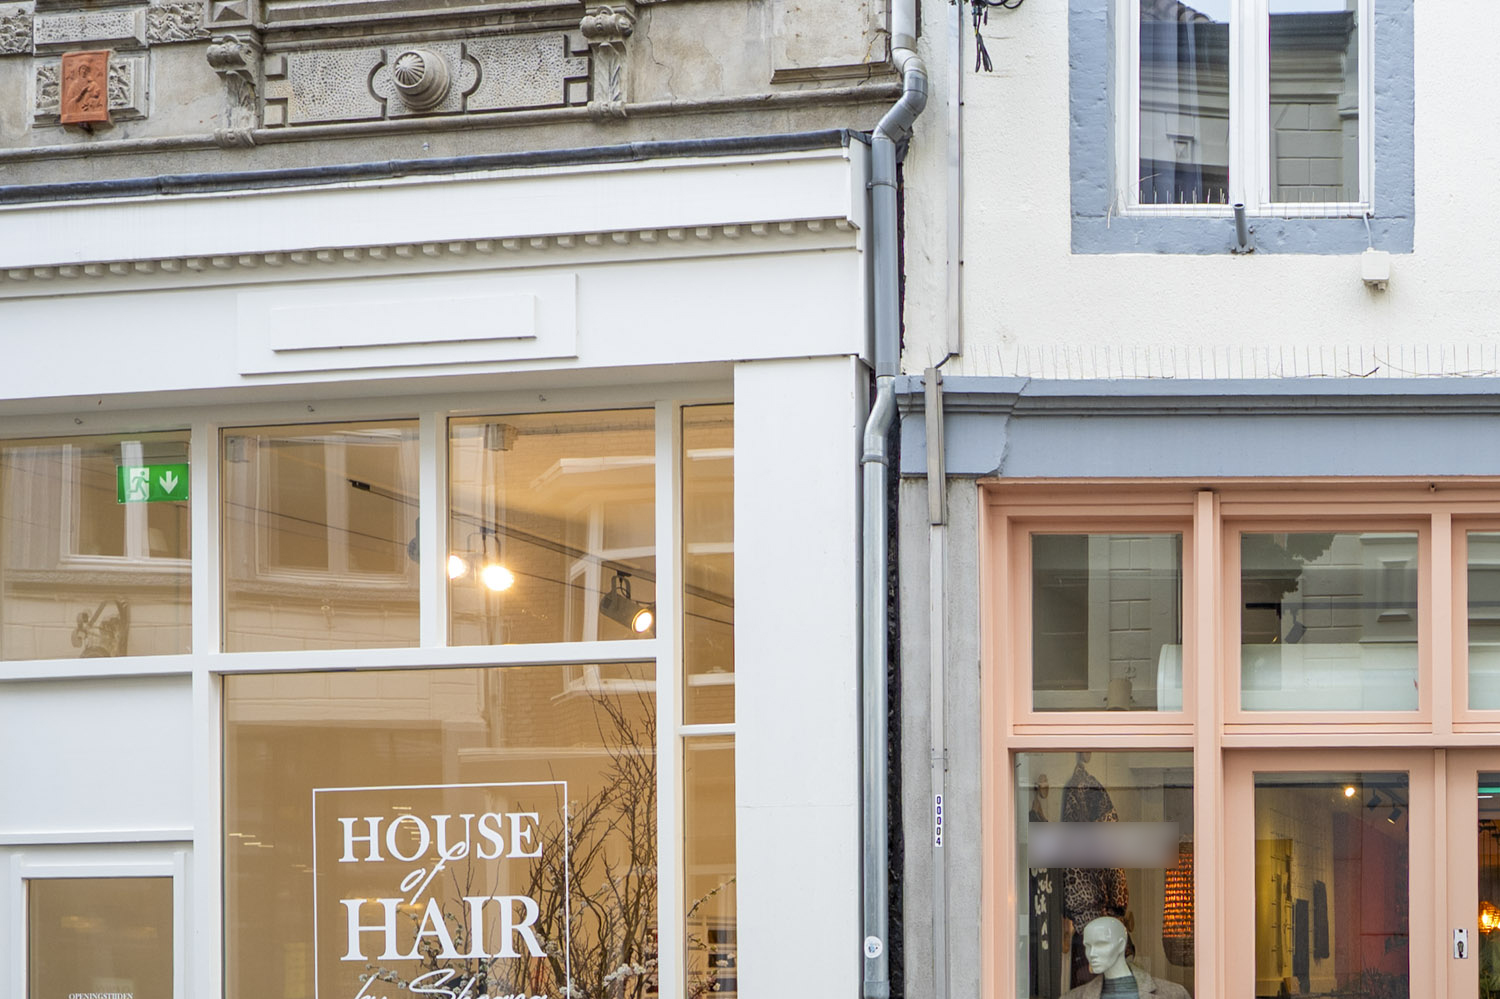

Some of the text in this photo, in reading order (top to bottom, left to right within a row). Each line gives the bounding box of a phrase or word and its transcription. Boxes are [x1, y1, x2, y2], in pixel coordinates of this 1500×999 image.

[338, 812, 543, 863] HOUSE
[400, 841, 468, 906] of
[339, 895, 548, 961] HAIR
[68, 992, 134, 999] OPENINGSTIJDEN
